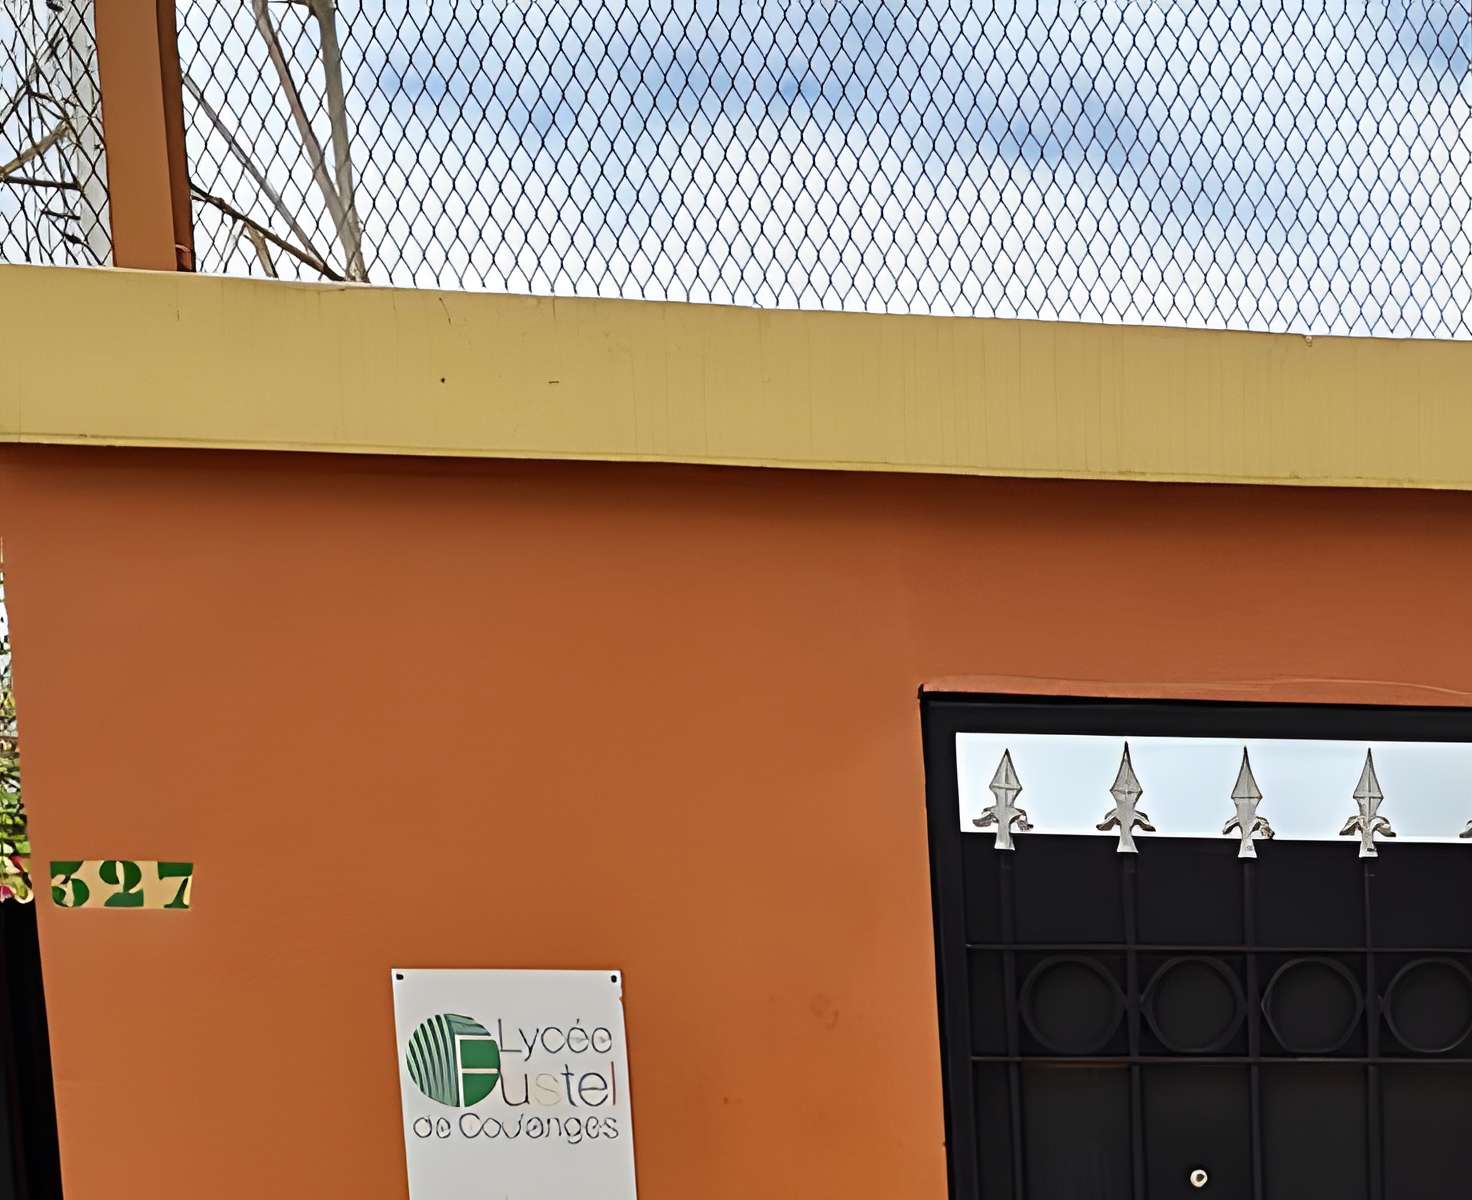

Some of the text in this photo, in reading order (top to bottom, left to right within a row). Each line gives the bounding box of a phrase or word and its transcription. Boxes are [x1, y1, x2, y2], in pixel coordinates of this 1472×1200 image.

[50, 860, 193, 908] 327
[498, 1018, 612, 1061] Lycée
[413, 1115, 450, 1139] de
